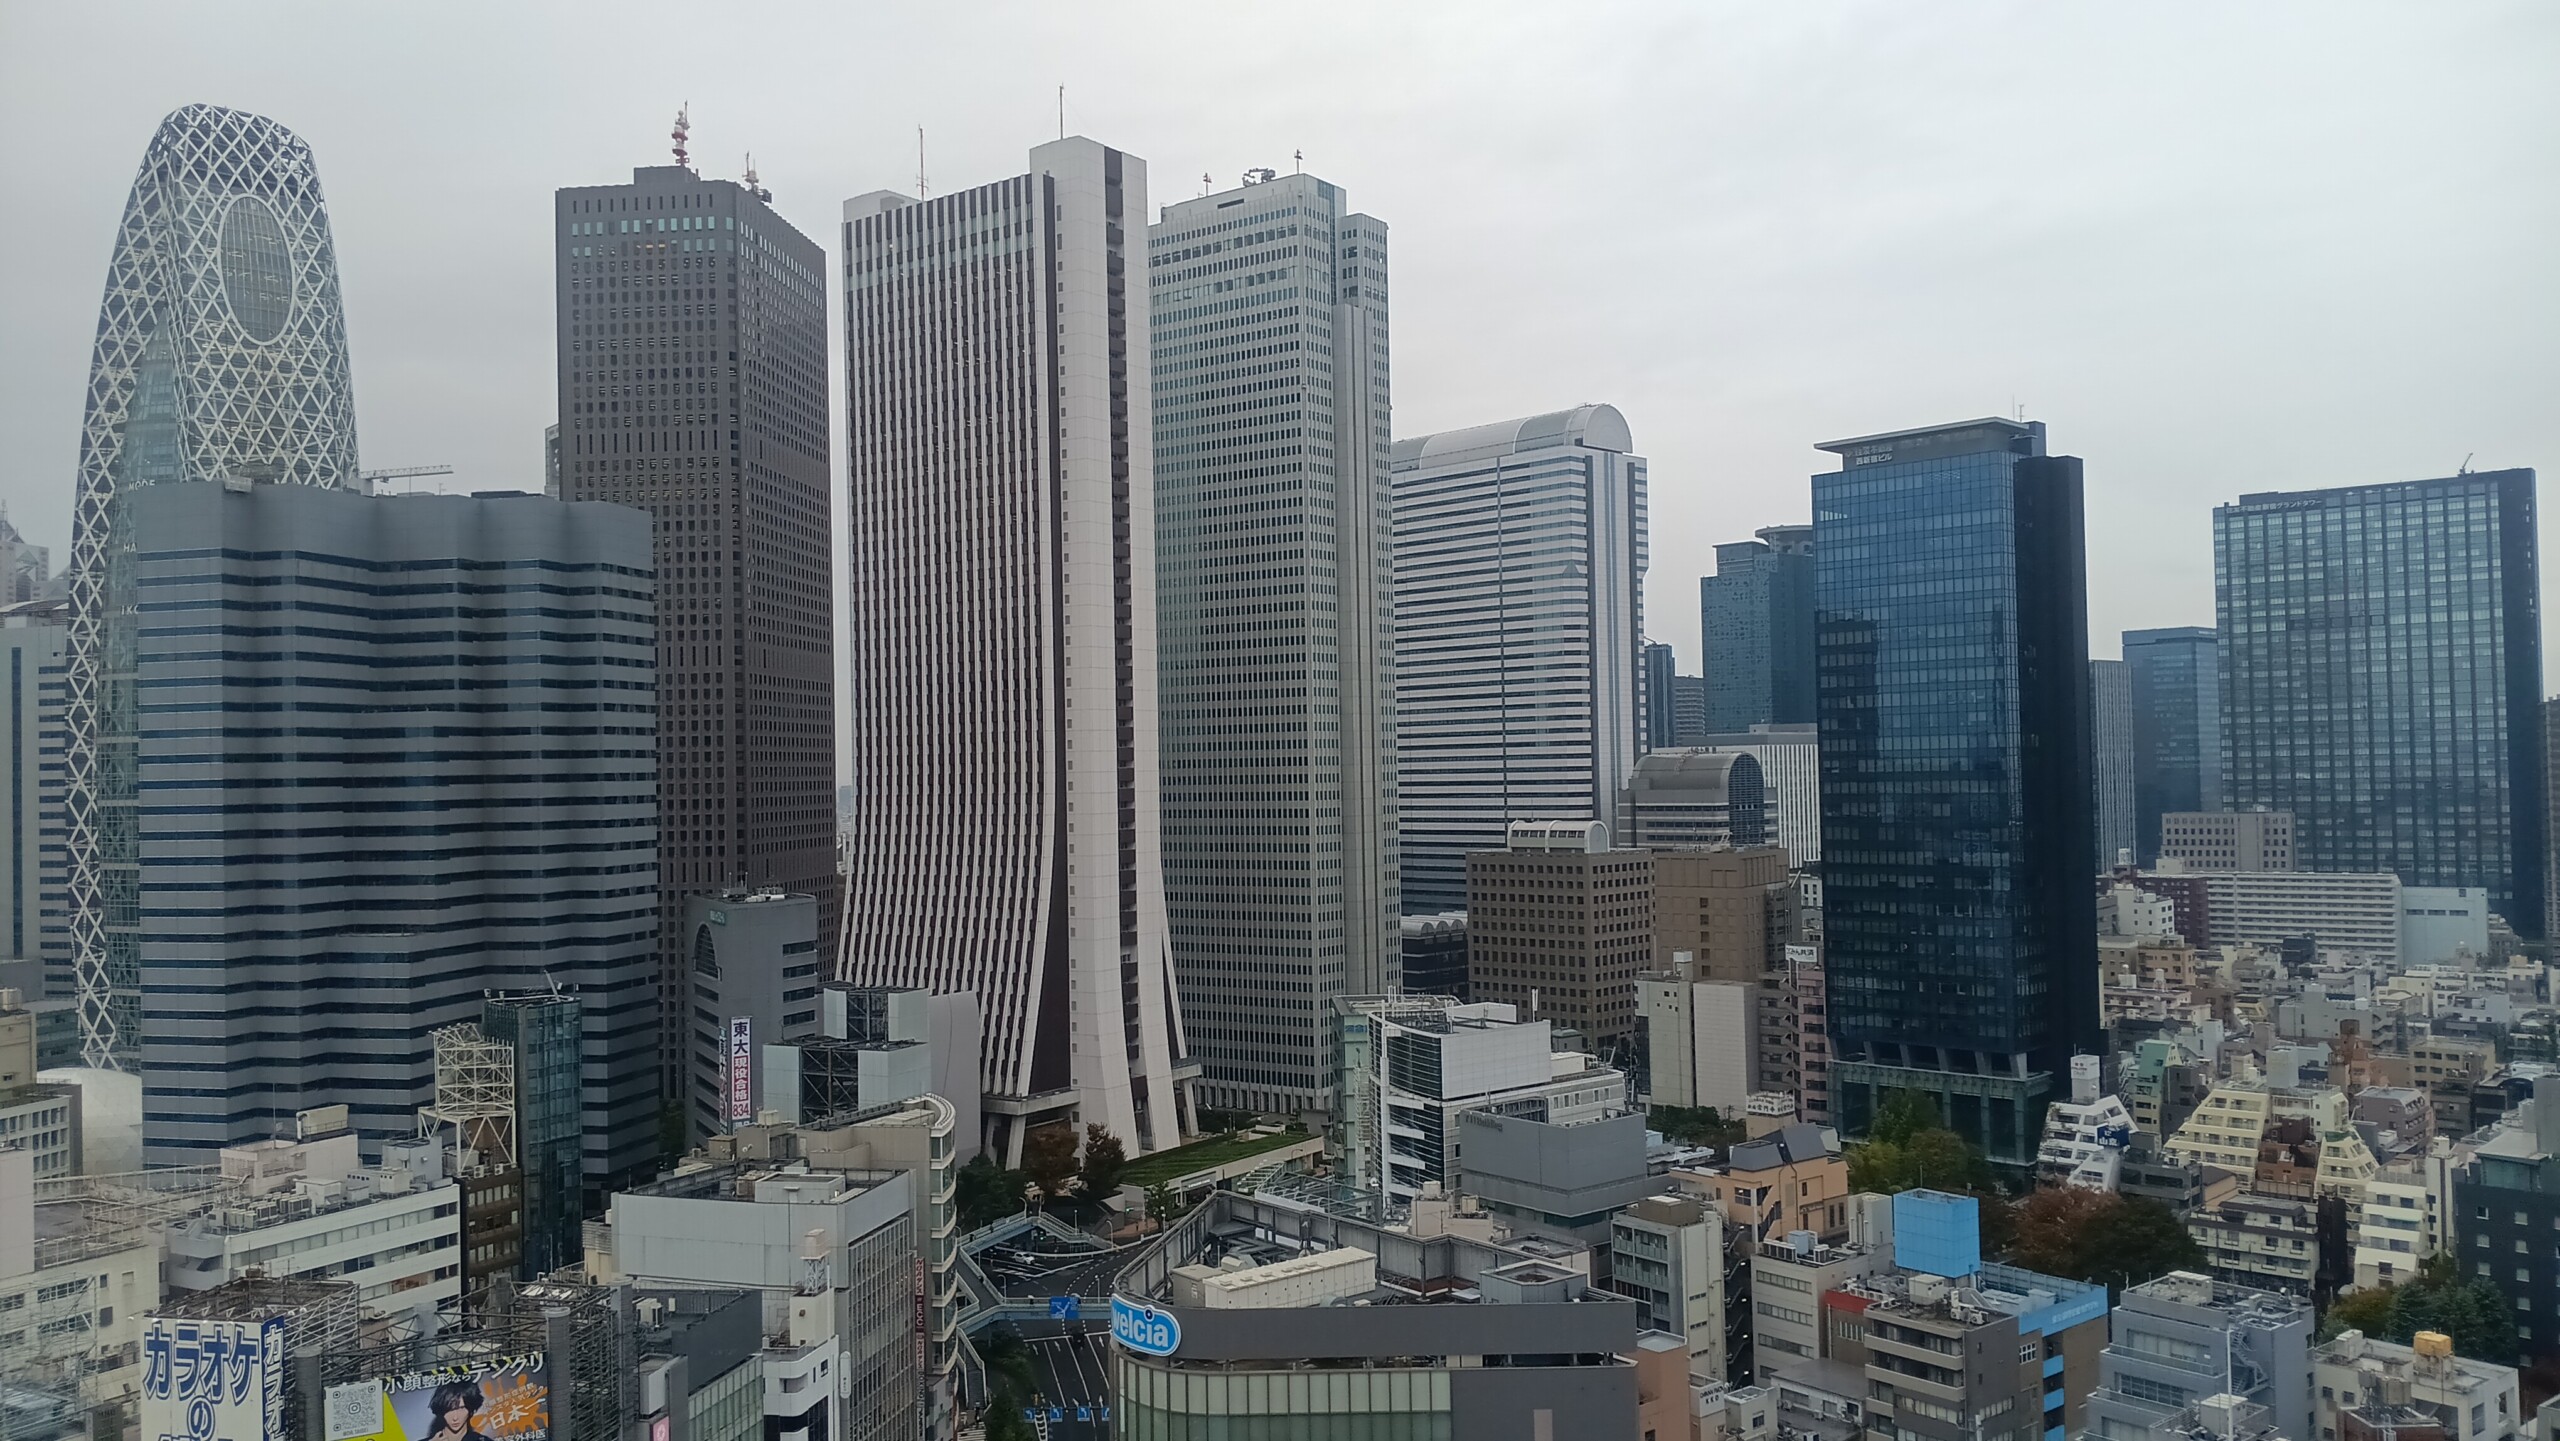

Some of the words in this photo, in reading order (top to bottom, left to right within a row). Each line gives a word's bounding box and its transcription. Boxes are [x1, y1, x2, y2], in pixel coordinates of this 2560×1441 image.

[916, 1303, 924, 1326] ECC
[1112, 1306, 1169, 1348] welcia
[143, 1320, 260, 1407] カラオケ
[186, 1394, 216, 1440] の
[490, 1398, 546, 1430] 日本一
